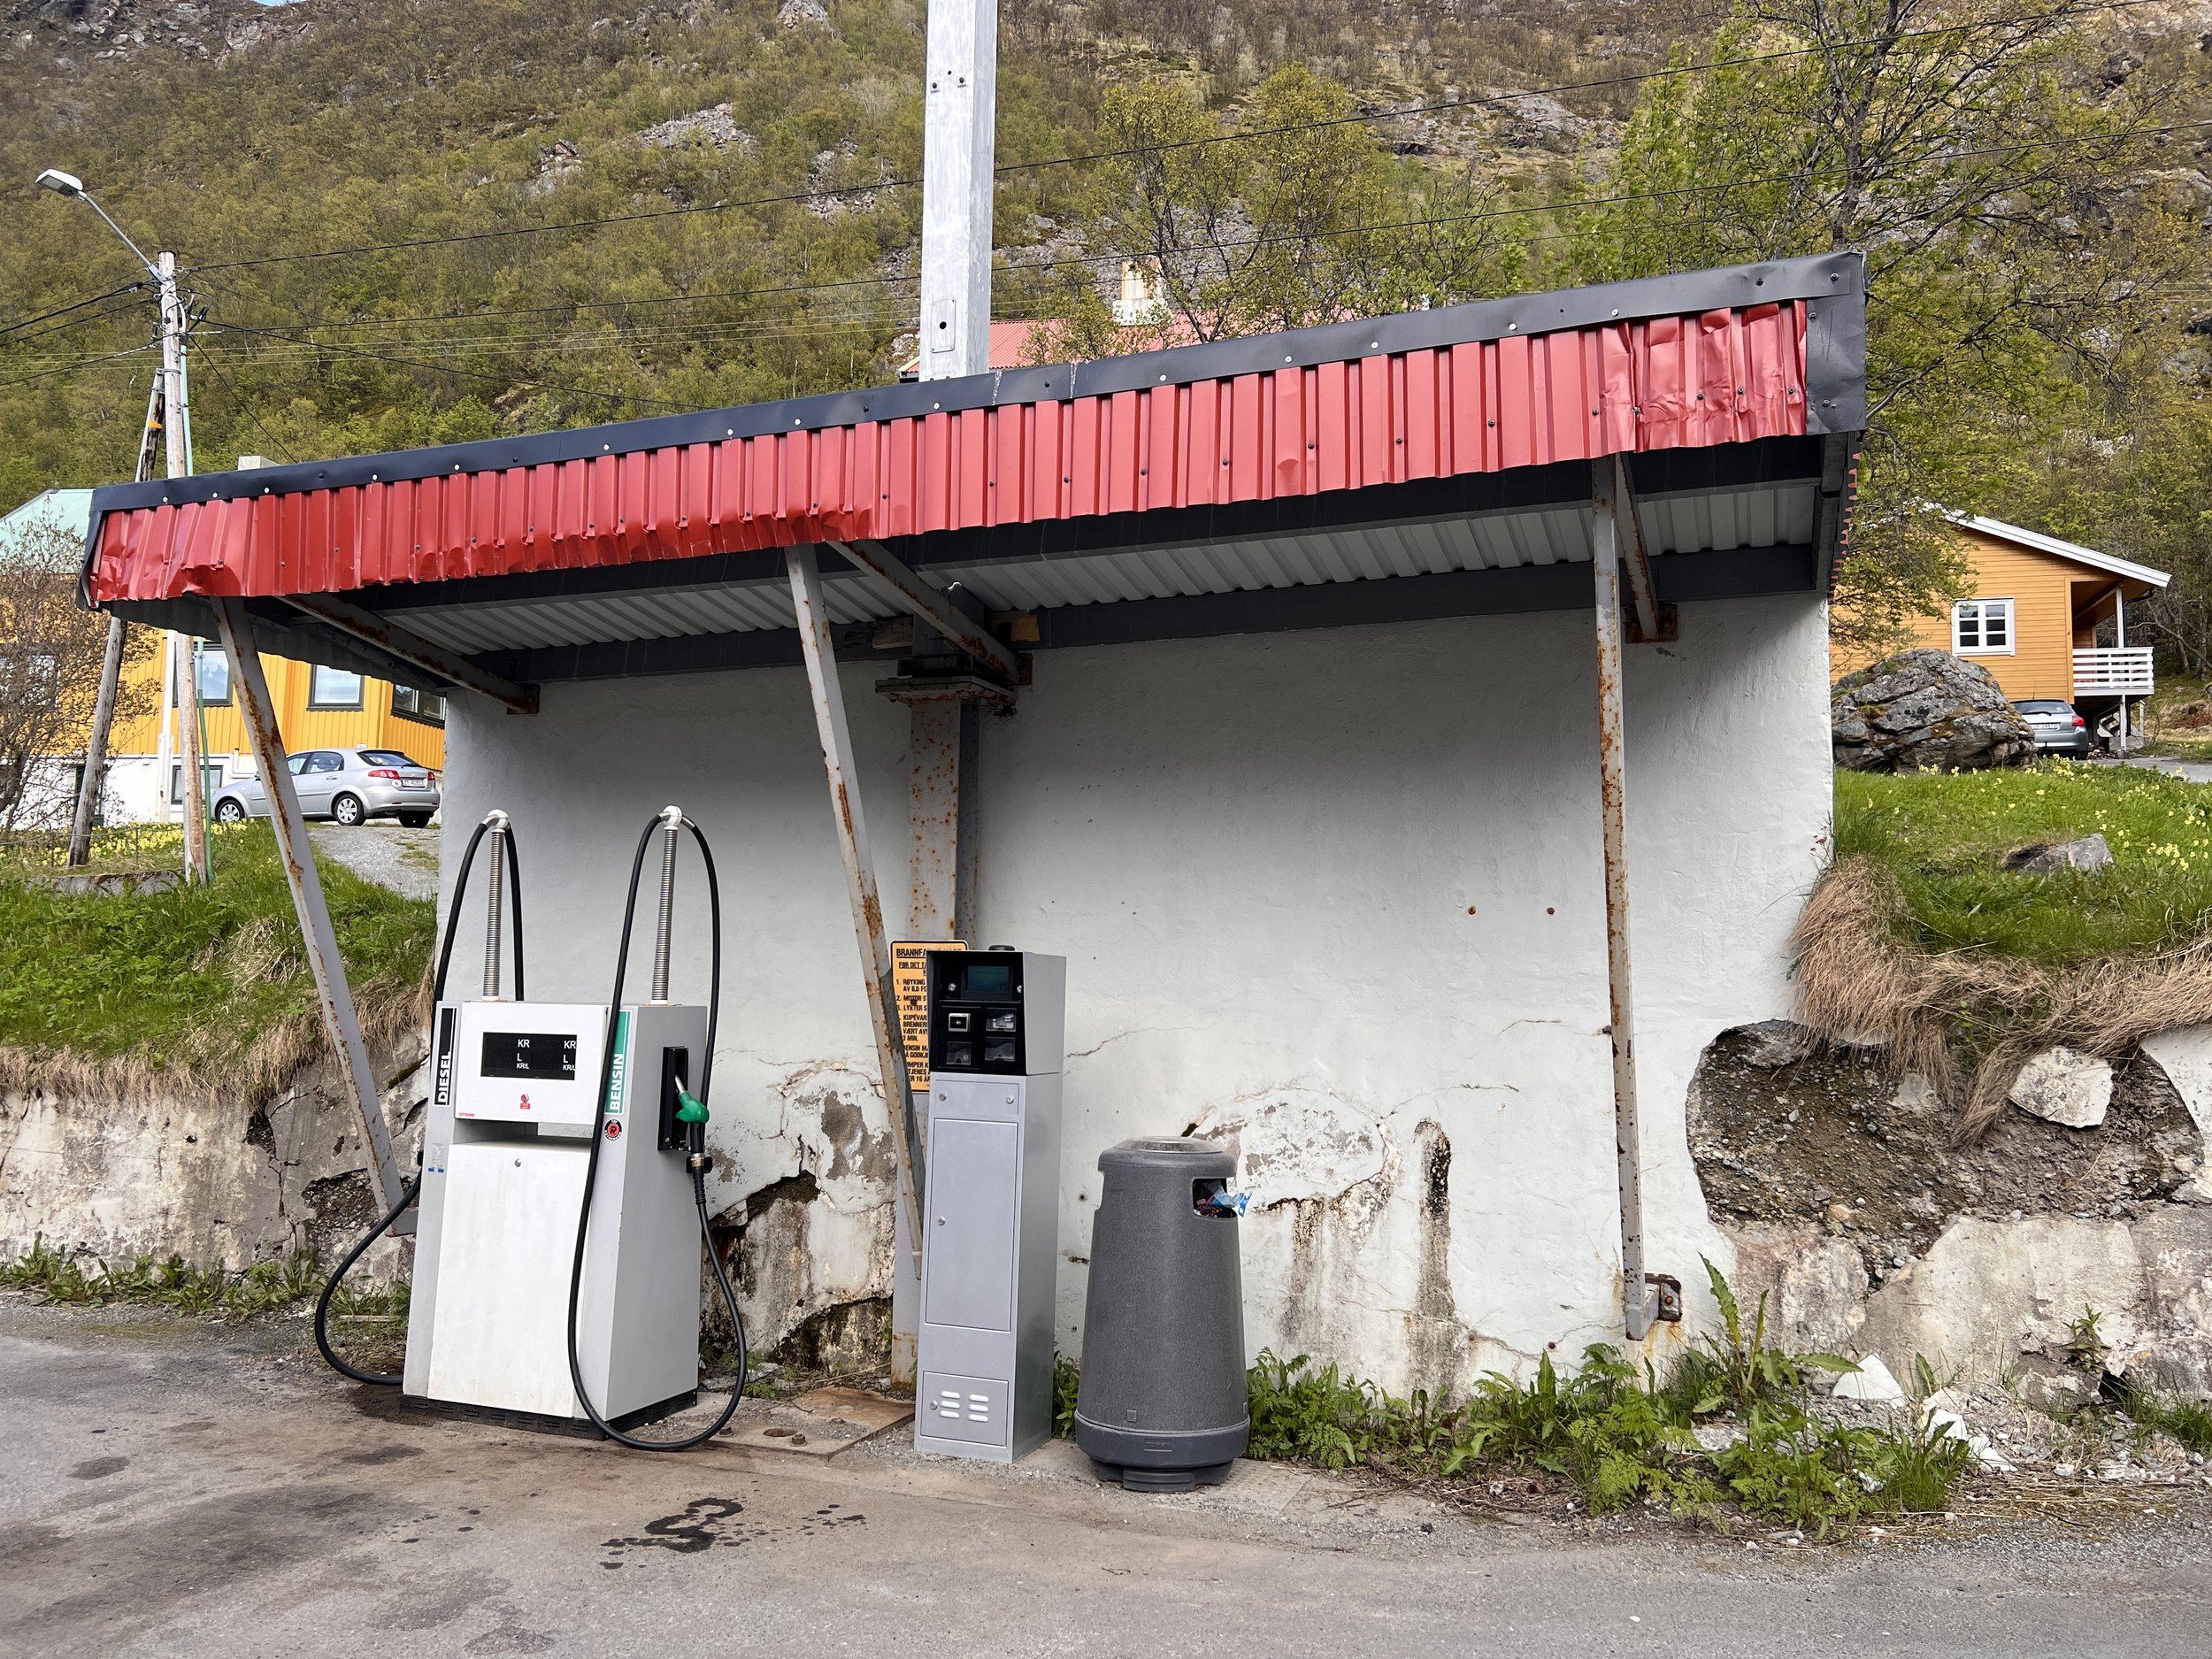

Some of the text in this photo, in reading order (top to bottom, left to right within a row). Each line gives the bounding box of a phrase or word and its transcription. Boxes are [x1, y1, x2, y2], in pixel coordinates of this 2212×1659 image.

[517, 1039, 577, 1049] KR KR
[517, 1053, 569, 1064] L L
[437, 1051, 451, 1103] DIESEL
[610, 1053, 624, 1110] BENSIN
[611, 1125, 618, 1135] R
